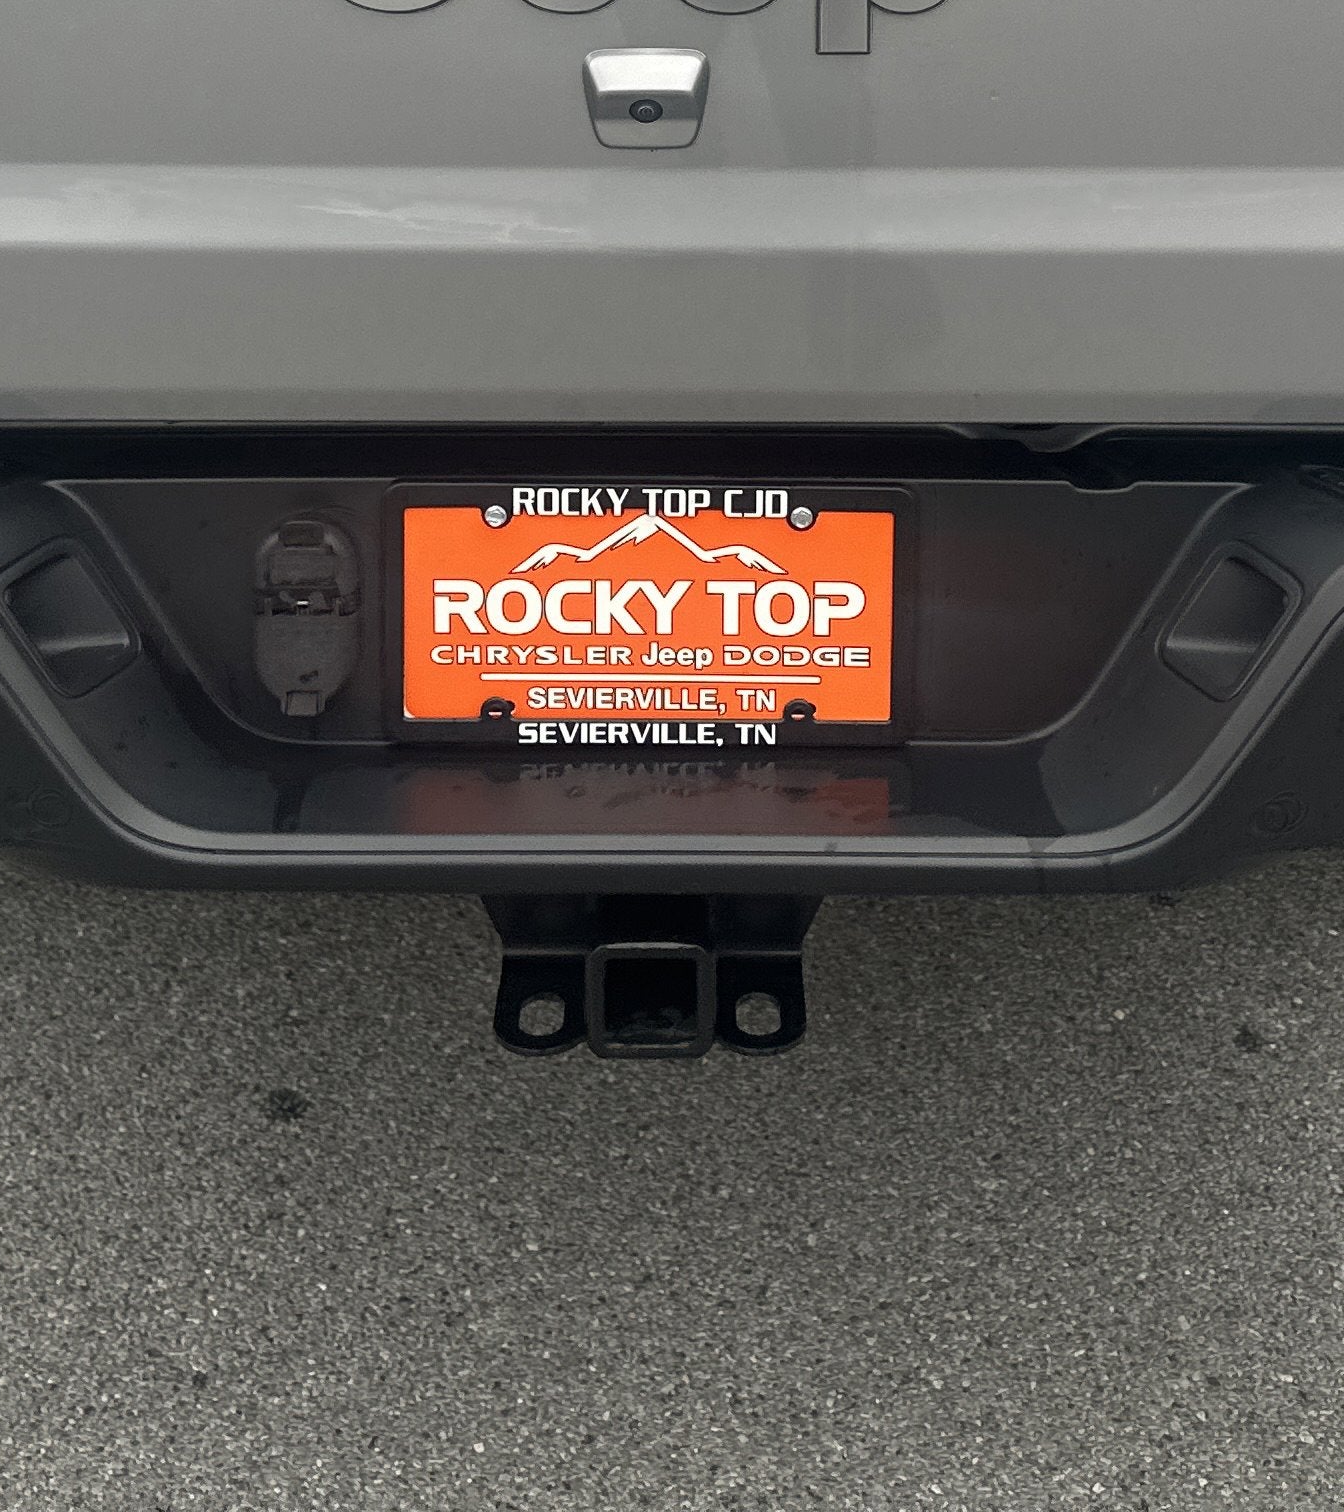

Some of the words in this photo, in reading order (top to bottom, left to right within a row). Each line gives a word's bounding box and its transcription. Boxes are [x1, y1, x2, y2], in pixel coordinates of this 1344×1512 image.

[511, 487, 630, 517] ROCKY
[642, 488, 712, 518] TOP
[723, 489, 789, 519] CJD
[432, 578, 694, 636] ROCKY
[706, 580, 868, 637] TOP
[430, 644, 635, 666] CHRYSLER
[641, 642, 715, 670] Jeep
[723, 645, 872, 668] DODGE
[526, 687, 728, 716] SEVIERVILLE,
[736, 690, 777, 712] TN
[517, 722, 725, 746] SEVIERVILLE,
[735, 723, 778, 746] TN
